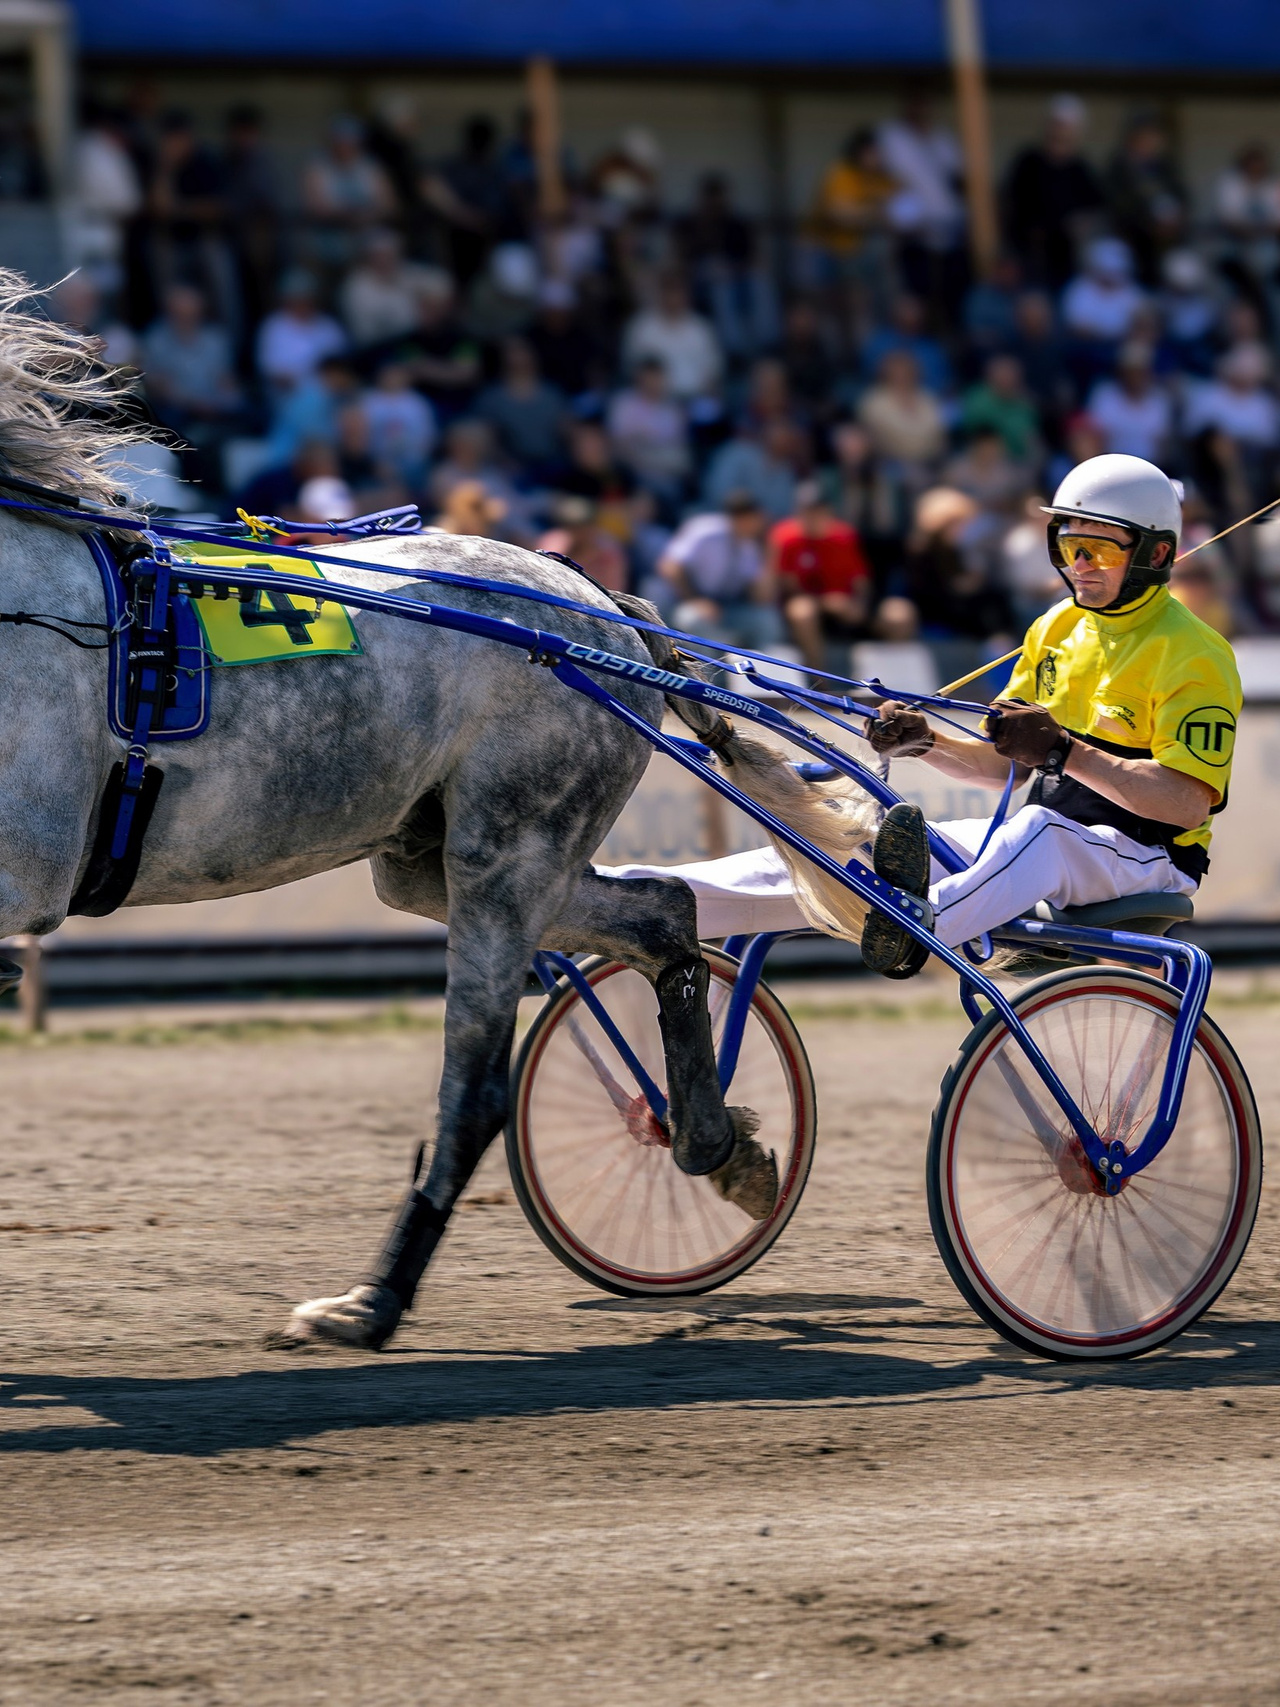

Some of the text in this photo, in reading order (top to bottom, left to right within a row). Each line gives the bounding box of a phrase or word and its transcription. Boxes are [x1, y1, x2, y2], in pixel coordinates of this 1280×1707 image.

[239, 562, 314, 645] 4
[565, 642, 761, 717] CUSTOM SPEEDSTER
